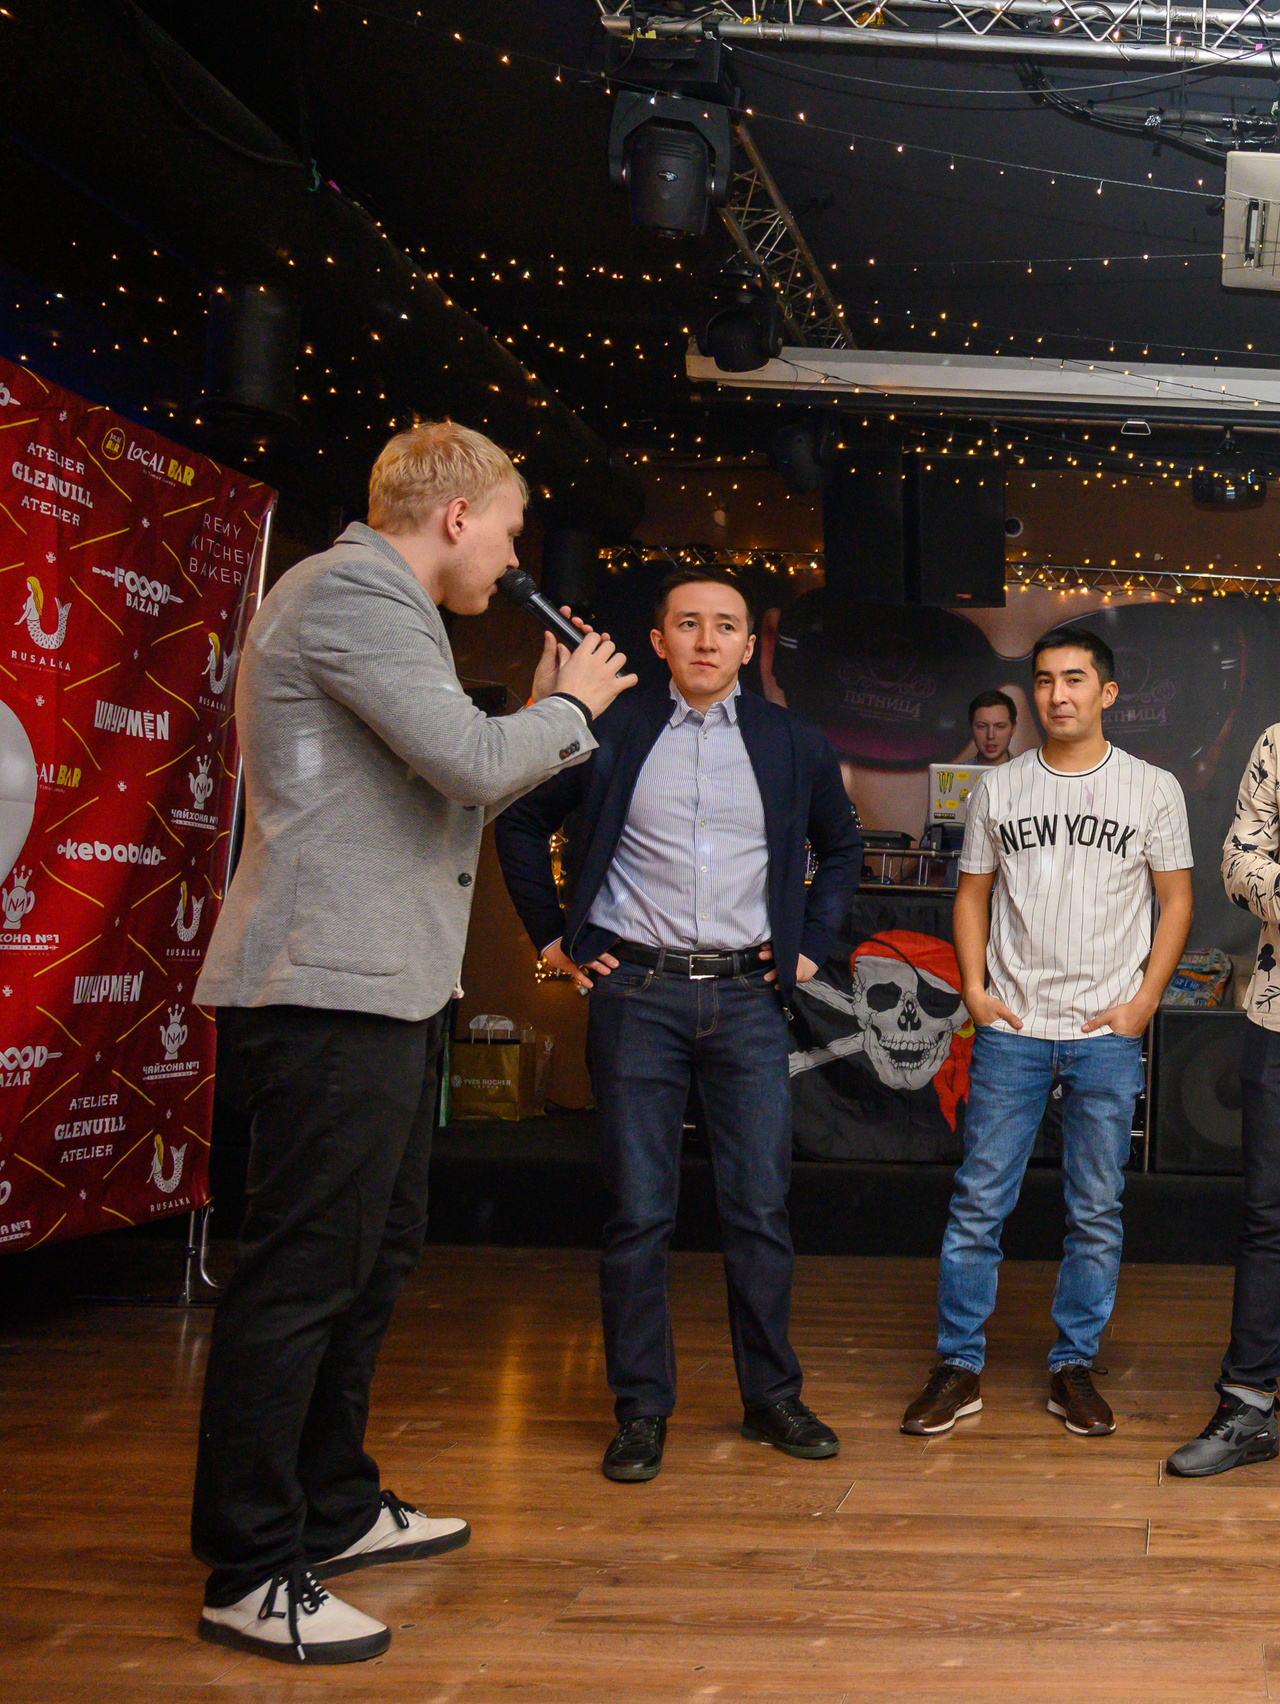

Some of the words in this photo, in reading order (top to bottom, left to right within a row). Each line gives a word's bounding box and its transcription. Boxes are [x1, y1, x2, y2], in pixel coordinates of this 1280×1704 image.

[27, 442, 85, 475] ATELIER
[127, 441, 165, 474] LOCAL
[167, 458, 195, 486] BAR
[11, 461, 94, 508] GLENUILL
[21, 495, 81, 526] ATELIER
[203, 513, 241, 539] REMY
[189, 557, 246, 585] BAKER
[126, 592, 160, 617] BAZAR
[11, 650, 71, 671] RUSALKA
[1101, 707, 1168, 724] ЯТНИЦА
[57, 764, 82, 788] BAR
[999, 813, 1058, 856] NEW
[1064, 813, 1137, 859] YORK
[65, 838, 161, 866] kebablab
[142, 1062, 185, 1075] ЧАЙХОНА
[69, 1093, 119, 1111] ATELIER
[54, 1116, 126, 1140] GLENUILL
[60, 1144, 113, 1163] ATELIER
[150, 1196, 191, 1213] RUSALKA
